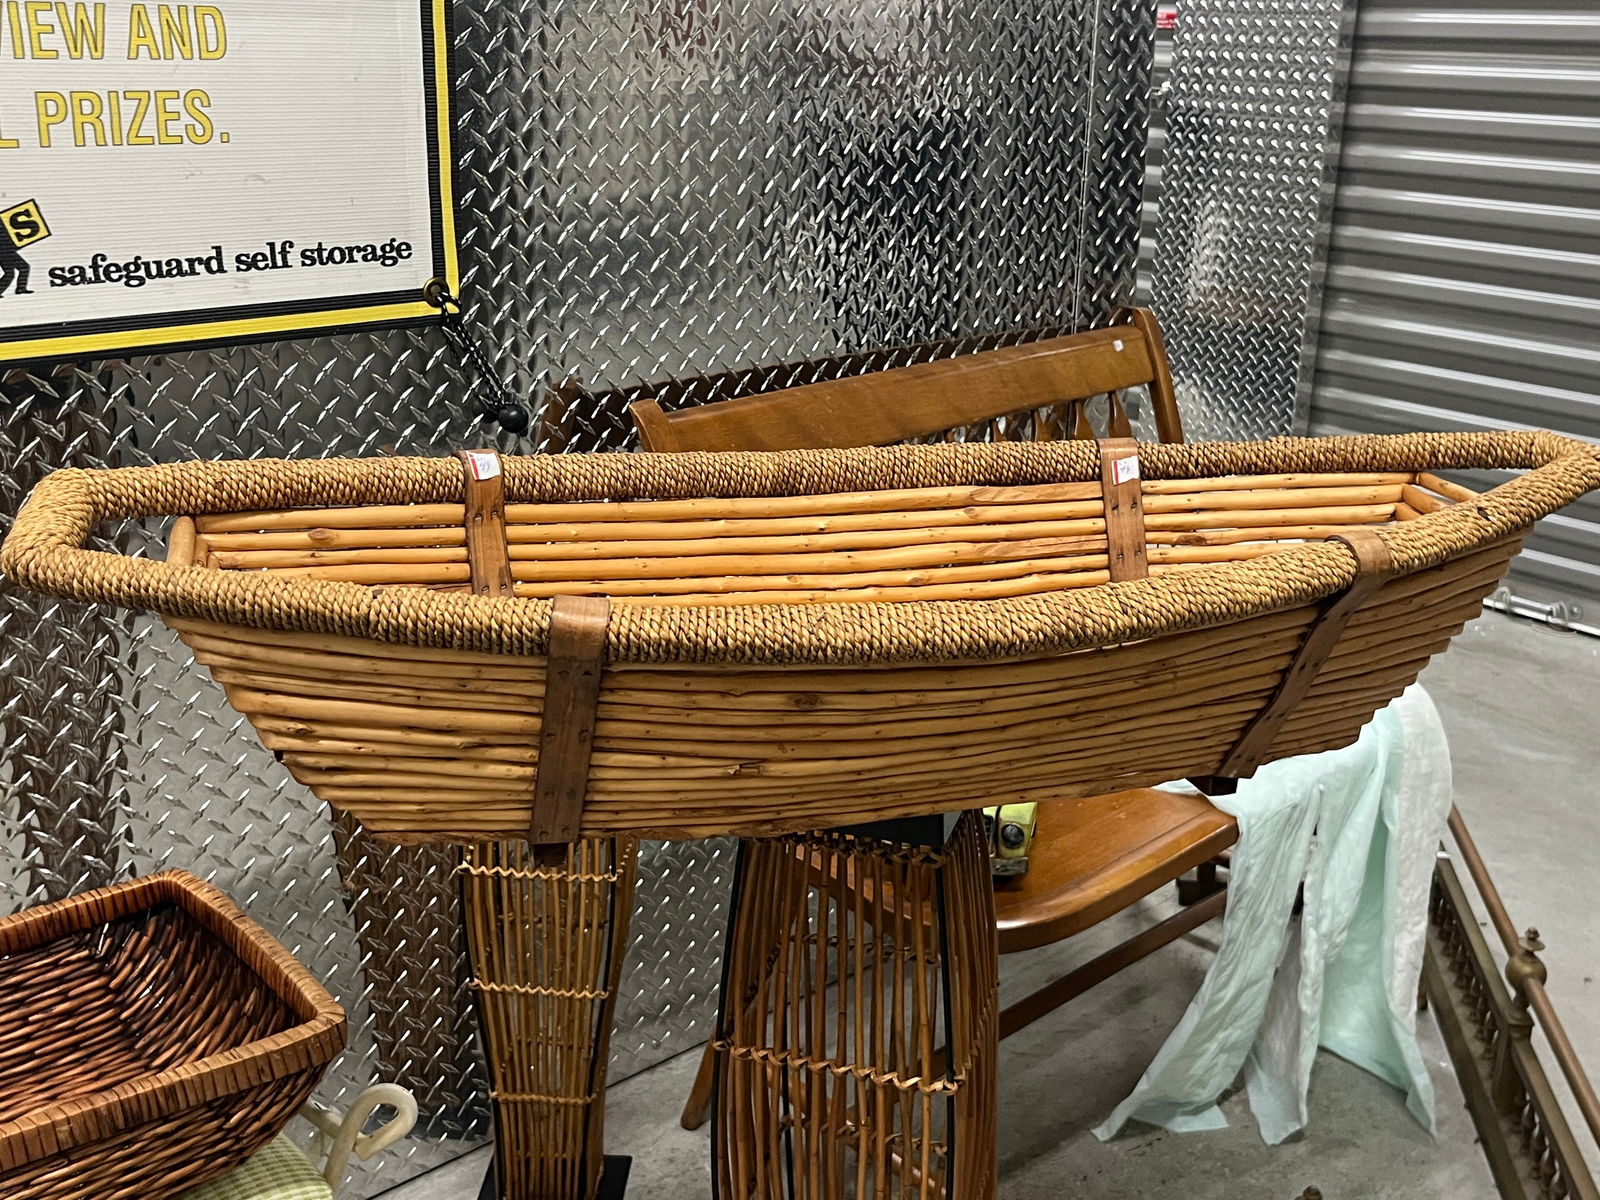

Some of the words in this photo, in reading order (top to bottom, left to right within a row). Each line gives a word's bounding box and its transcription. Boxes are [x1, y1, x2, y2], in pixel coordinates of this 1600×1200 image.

[0, 0, 105, 59] IEW
[127, 3, 228, 60] AND
[34, 89, 230, 148] PRIZES.
[8, 208, 40, 243] S
[48, 246, 228, 288] safeguard
[235, 240, 294, 272] self
[300, 237, 413, 267] storage
